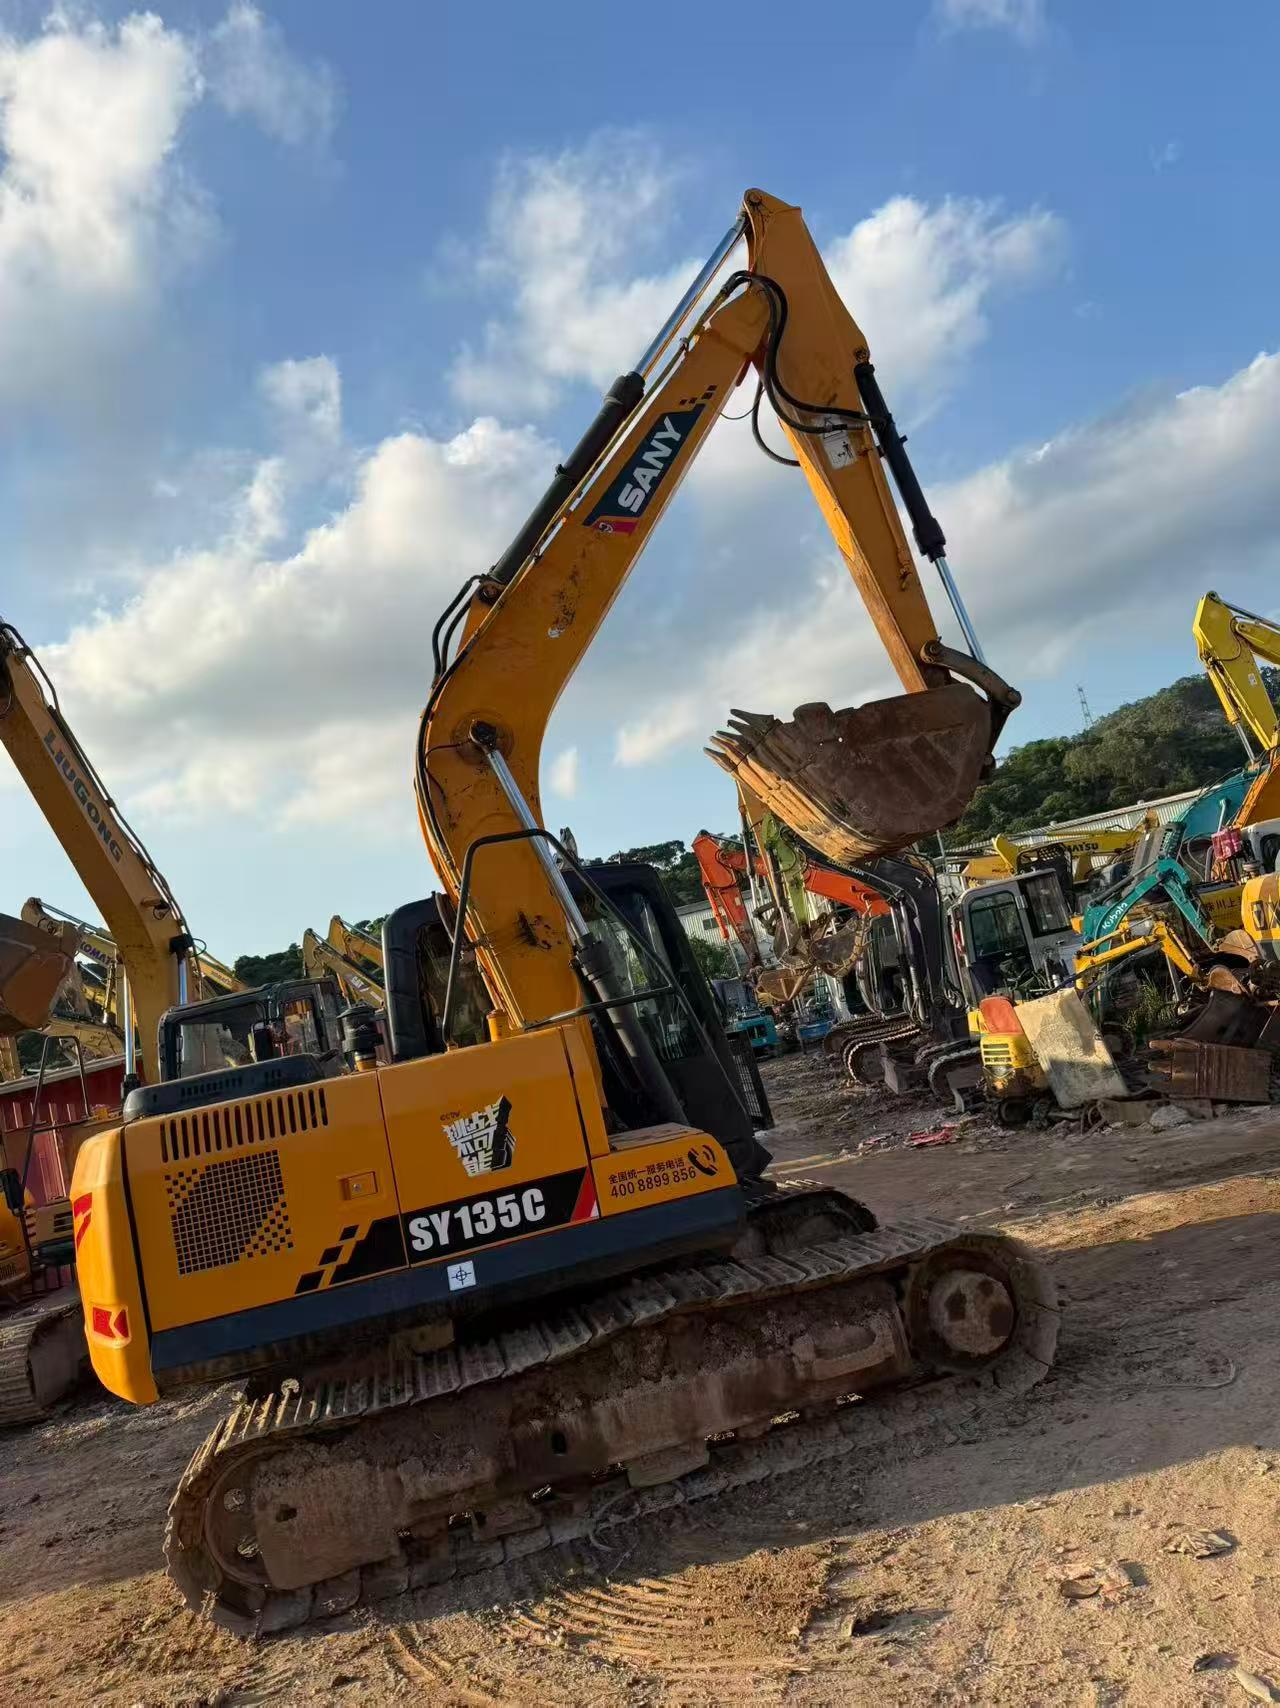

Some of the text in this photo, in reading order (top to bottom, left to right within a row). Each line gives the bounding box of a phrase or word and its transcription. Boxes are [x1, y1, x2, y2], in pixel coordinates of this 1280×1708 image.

[618, 416, 681, 513] SANY
[43, 729, 123, 863] LIUGONG
[1102, 902, 1128, 930] Kubota
[608, 1157, 685, 1185] 全国统一服务电话
[610, 1166, 697, 1198] 400 8899 856
[408, 1188, 546, 1252] SY135C
